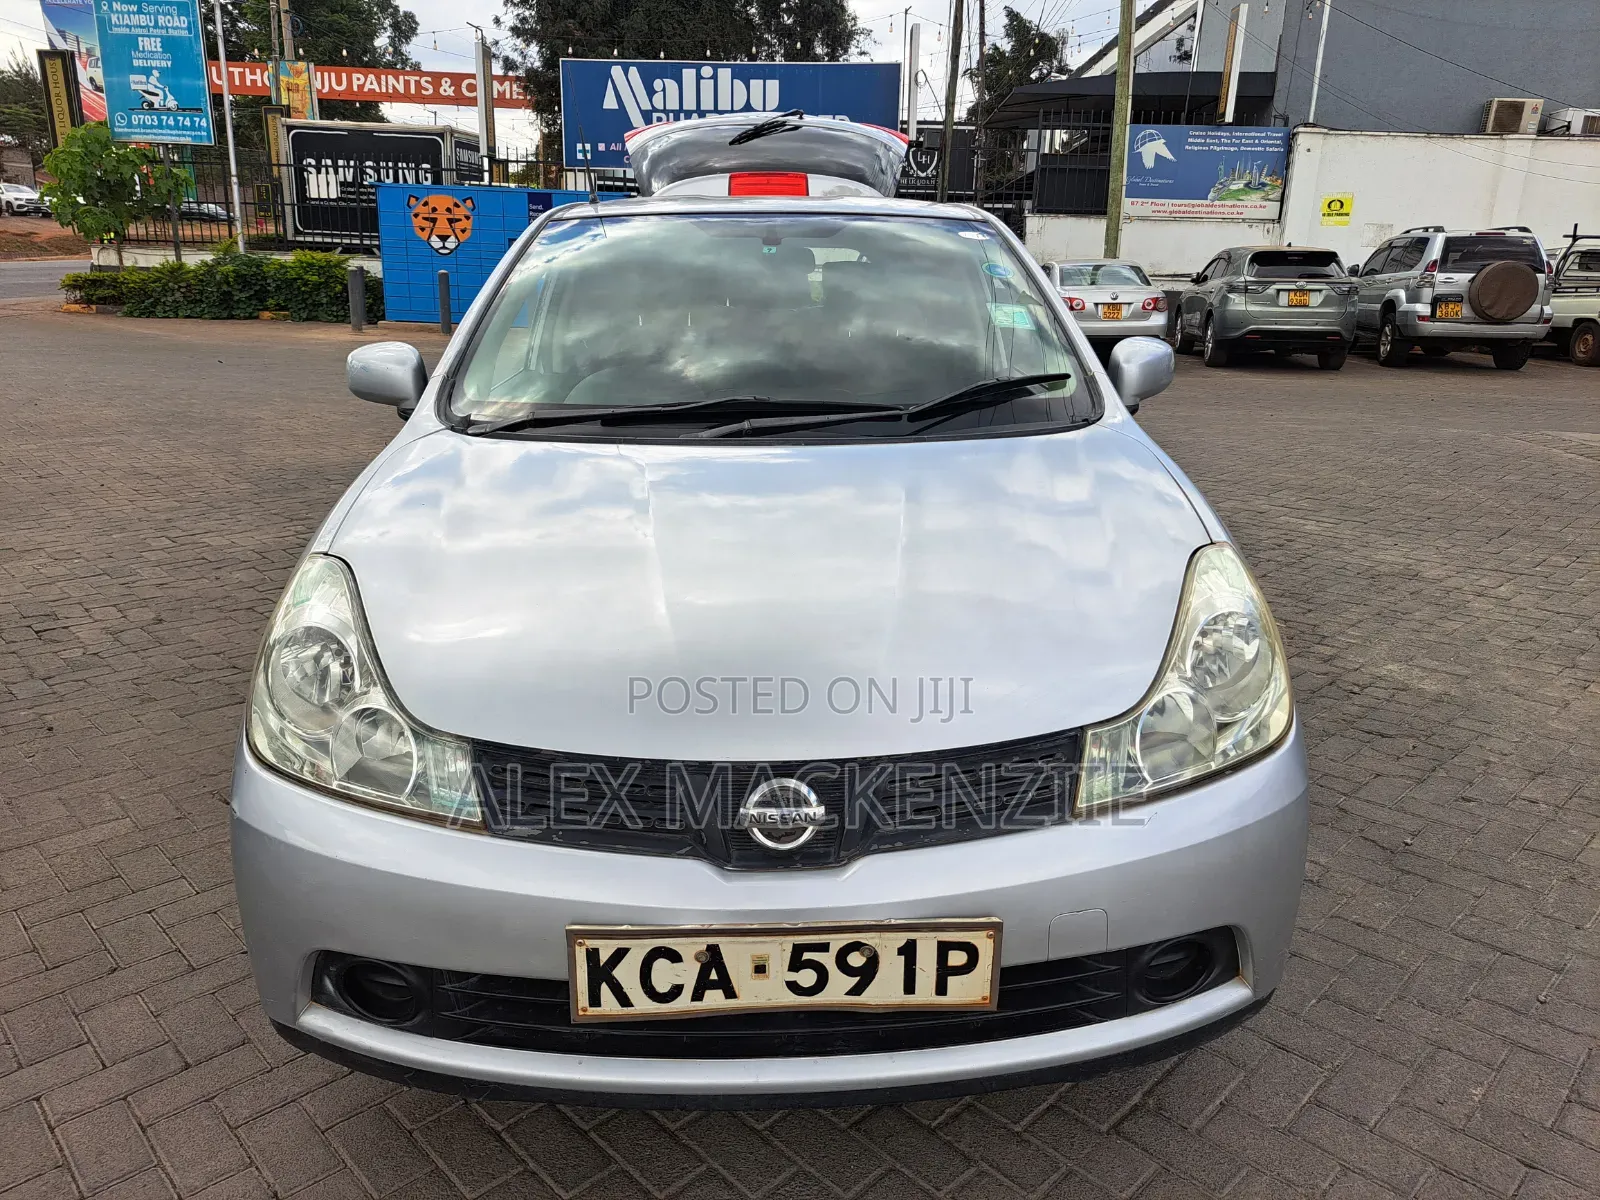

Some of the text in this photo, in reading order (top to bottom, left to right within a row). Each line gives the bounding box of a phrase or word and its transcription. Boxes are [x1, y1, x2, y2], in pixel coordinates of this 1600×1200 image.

[112, 2, 178, 15] Now Serving
[111, 14, 187, 27] KIAMBU ROAD
[138, 37, 162, 51] FREE
[132, 50, 172, 59] Medication
[132, 60, 172, 68] DELIVERY
[352, 74, 434, 95] PAINTS
[440, 78, 455, 96] &
[602, 65, 780, 128] Malibu
[55, 91, 66, 129] LIQUOR
[132, 115, 207, 128] 0703 74 74 74
[302, 158, 432, 185] SAMSUNG
[749, 812, 816, 824] NISSAN
[585, 939, 980, 1008] KCA 591P
